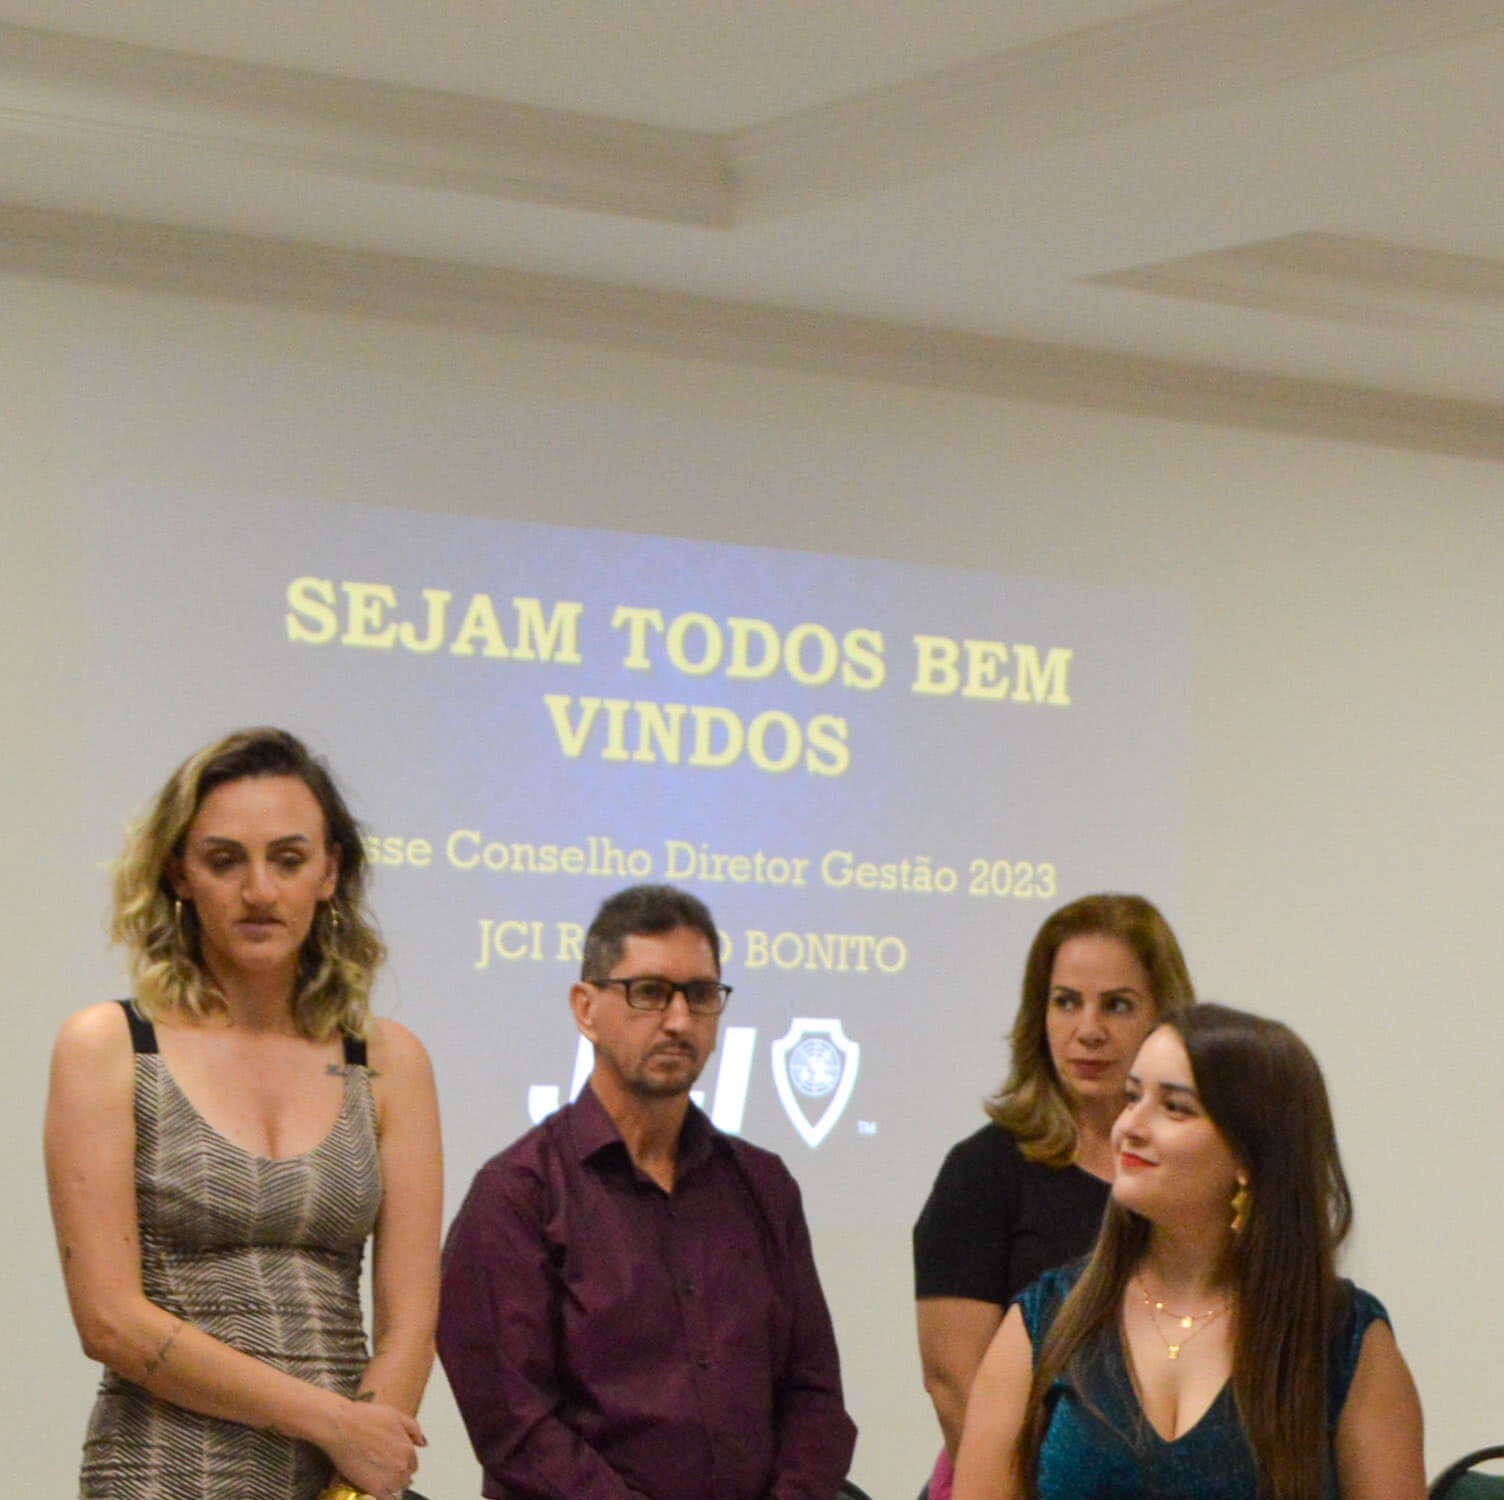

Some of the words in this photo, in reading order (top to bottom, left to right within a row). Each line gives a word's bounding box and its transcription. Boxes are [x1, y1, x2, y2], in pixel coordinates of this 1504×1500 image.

[286, 576, 584, 668] SEJAM
[612, 606, 887, 691] TODOS
[912, 635, 1073, 708] BEM
[544, 694, 851, 778] VINDOS
[362, 835, 434, 868] sse
[447, 828, 653, 880] Conselho
[664, 841, 809, 888] Diretor
[821, 850, 958, 894] Gestão
[969, 858, 1057, 899] 2023
[475, 918, 545, 970] JCI
[747, 930, 909, 975] BONITO
